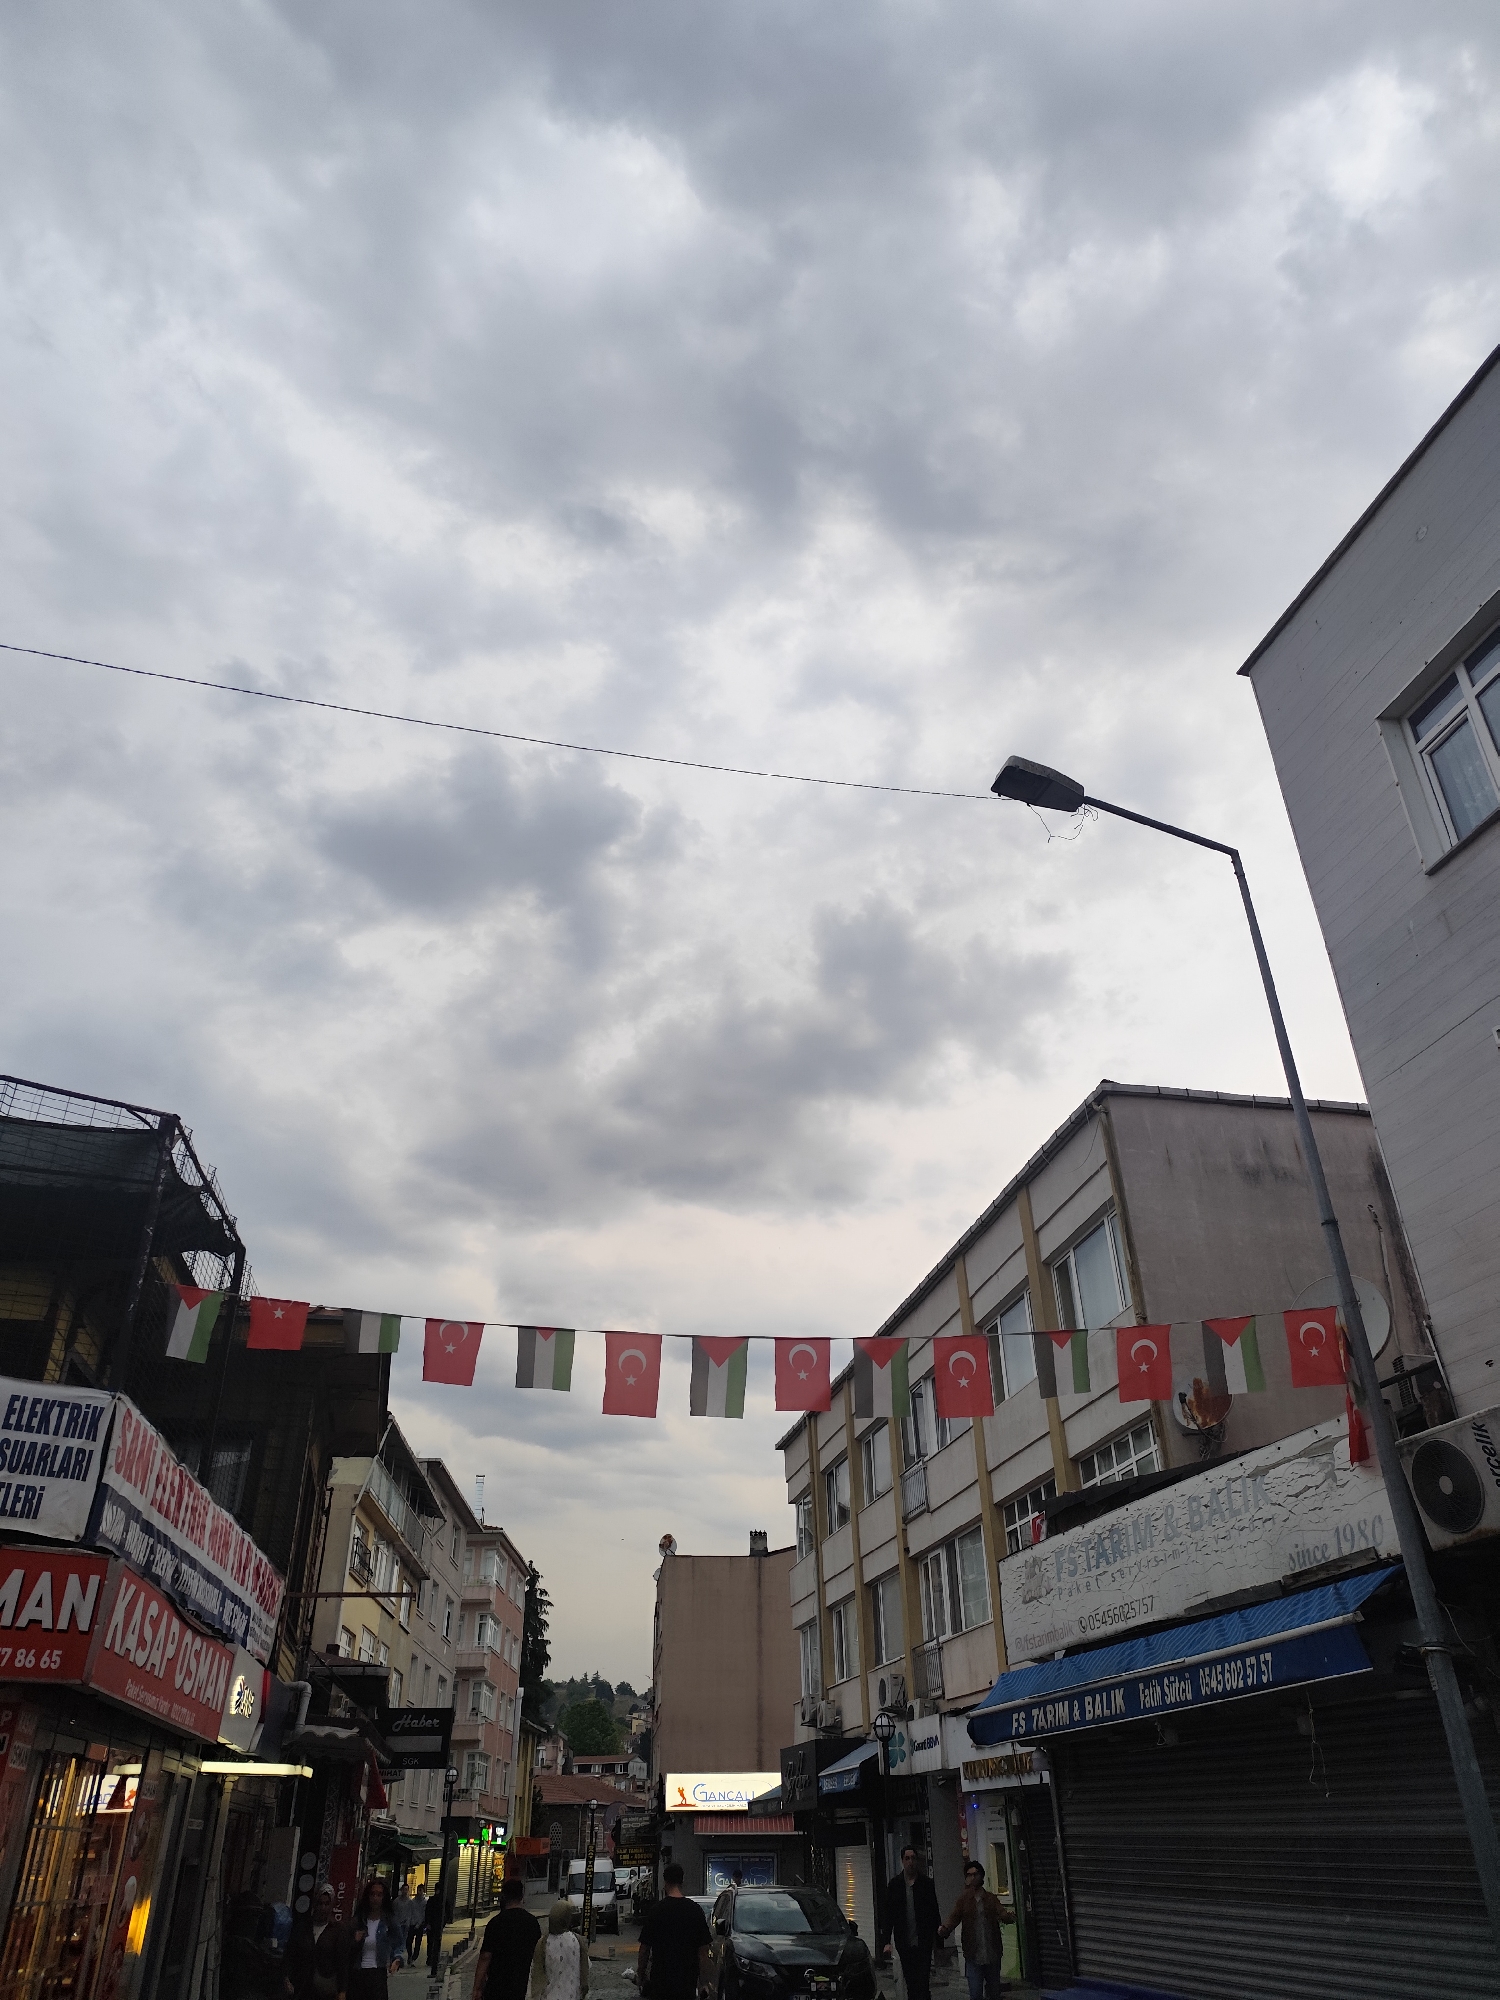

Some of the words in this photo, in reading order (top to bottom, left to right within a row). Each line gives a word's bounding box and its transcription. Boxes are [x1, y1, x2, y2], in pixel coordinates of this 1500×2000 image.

[2, 1394, 105, 1442] ELEKTRİK
[1054, 1548, 1078, 1582] FS
[1081, 1513, 1155, 1572] TARIM
[1163, 1504, 1182, 1542] &
[1188, 1475, 1273, 1532] BALIK
[1288, 1543, 1331, 1571] since
[1334, 1514, 1384, 1557] 1980
[14, 1648, 36, 1668] 86
[39, 1649, 63, 1670] 65
[105, 1577, 180, 1680] KASAP
[174, 1628, 230, 1713] OSMAN
[1011, 1713, 1026, 1735] FS
[1031, 1700, 1070, 1731] TARIM
[1073, 1703, 1082, 1722] &
[1084, 1687, 1126, 1720] BALIK
[1138, 1682, 1162, 1710] Fatih
[1163, 1672, 1193, 1705] Sütcü
[1199, 1667, 1224, 1697] 0545
[1224, 1660, 1244, 1691] 602
[1245, 1656, 1258, 1686] 57
[1260, 1651, 1273, 1682] 57
[392, 1715, 440, 1733] Haber
[402, 1757, 420, 1766] SGK
